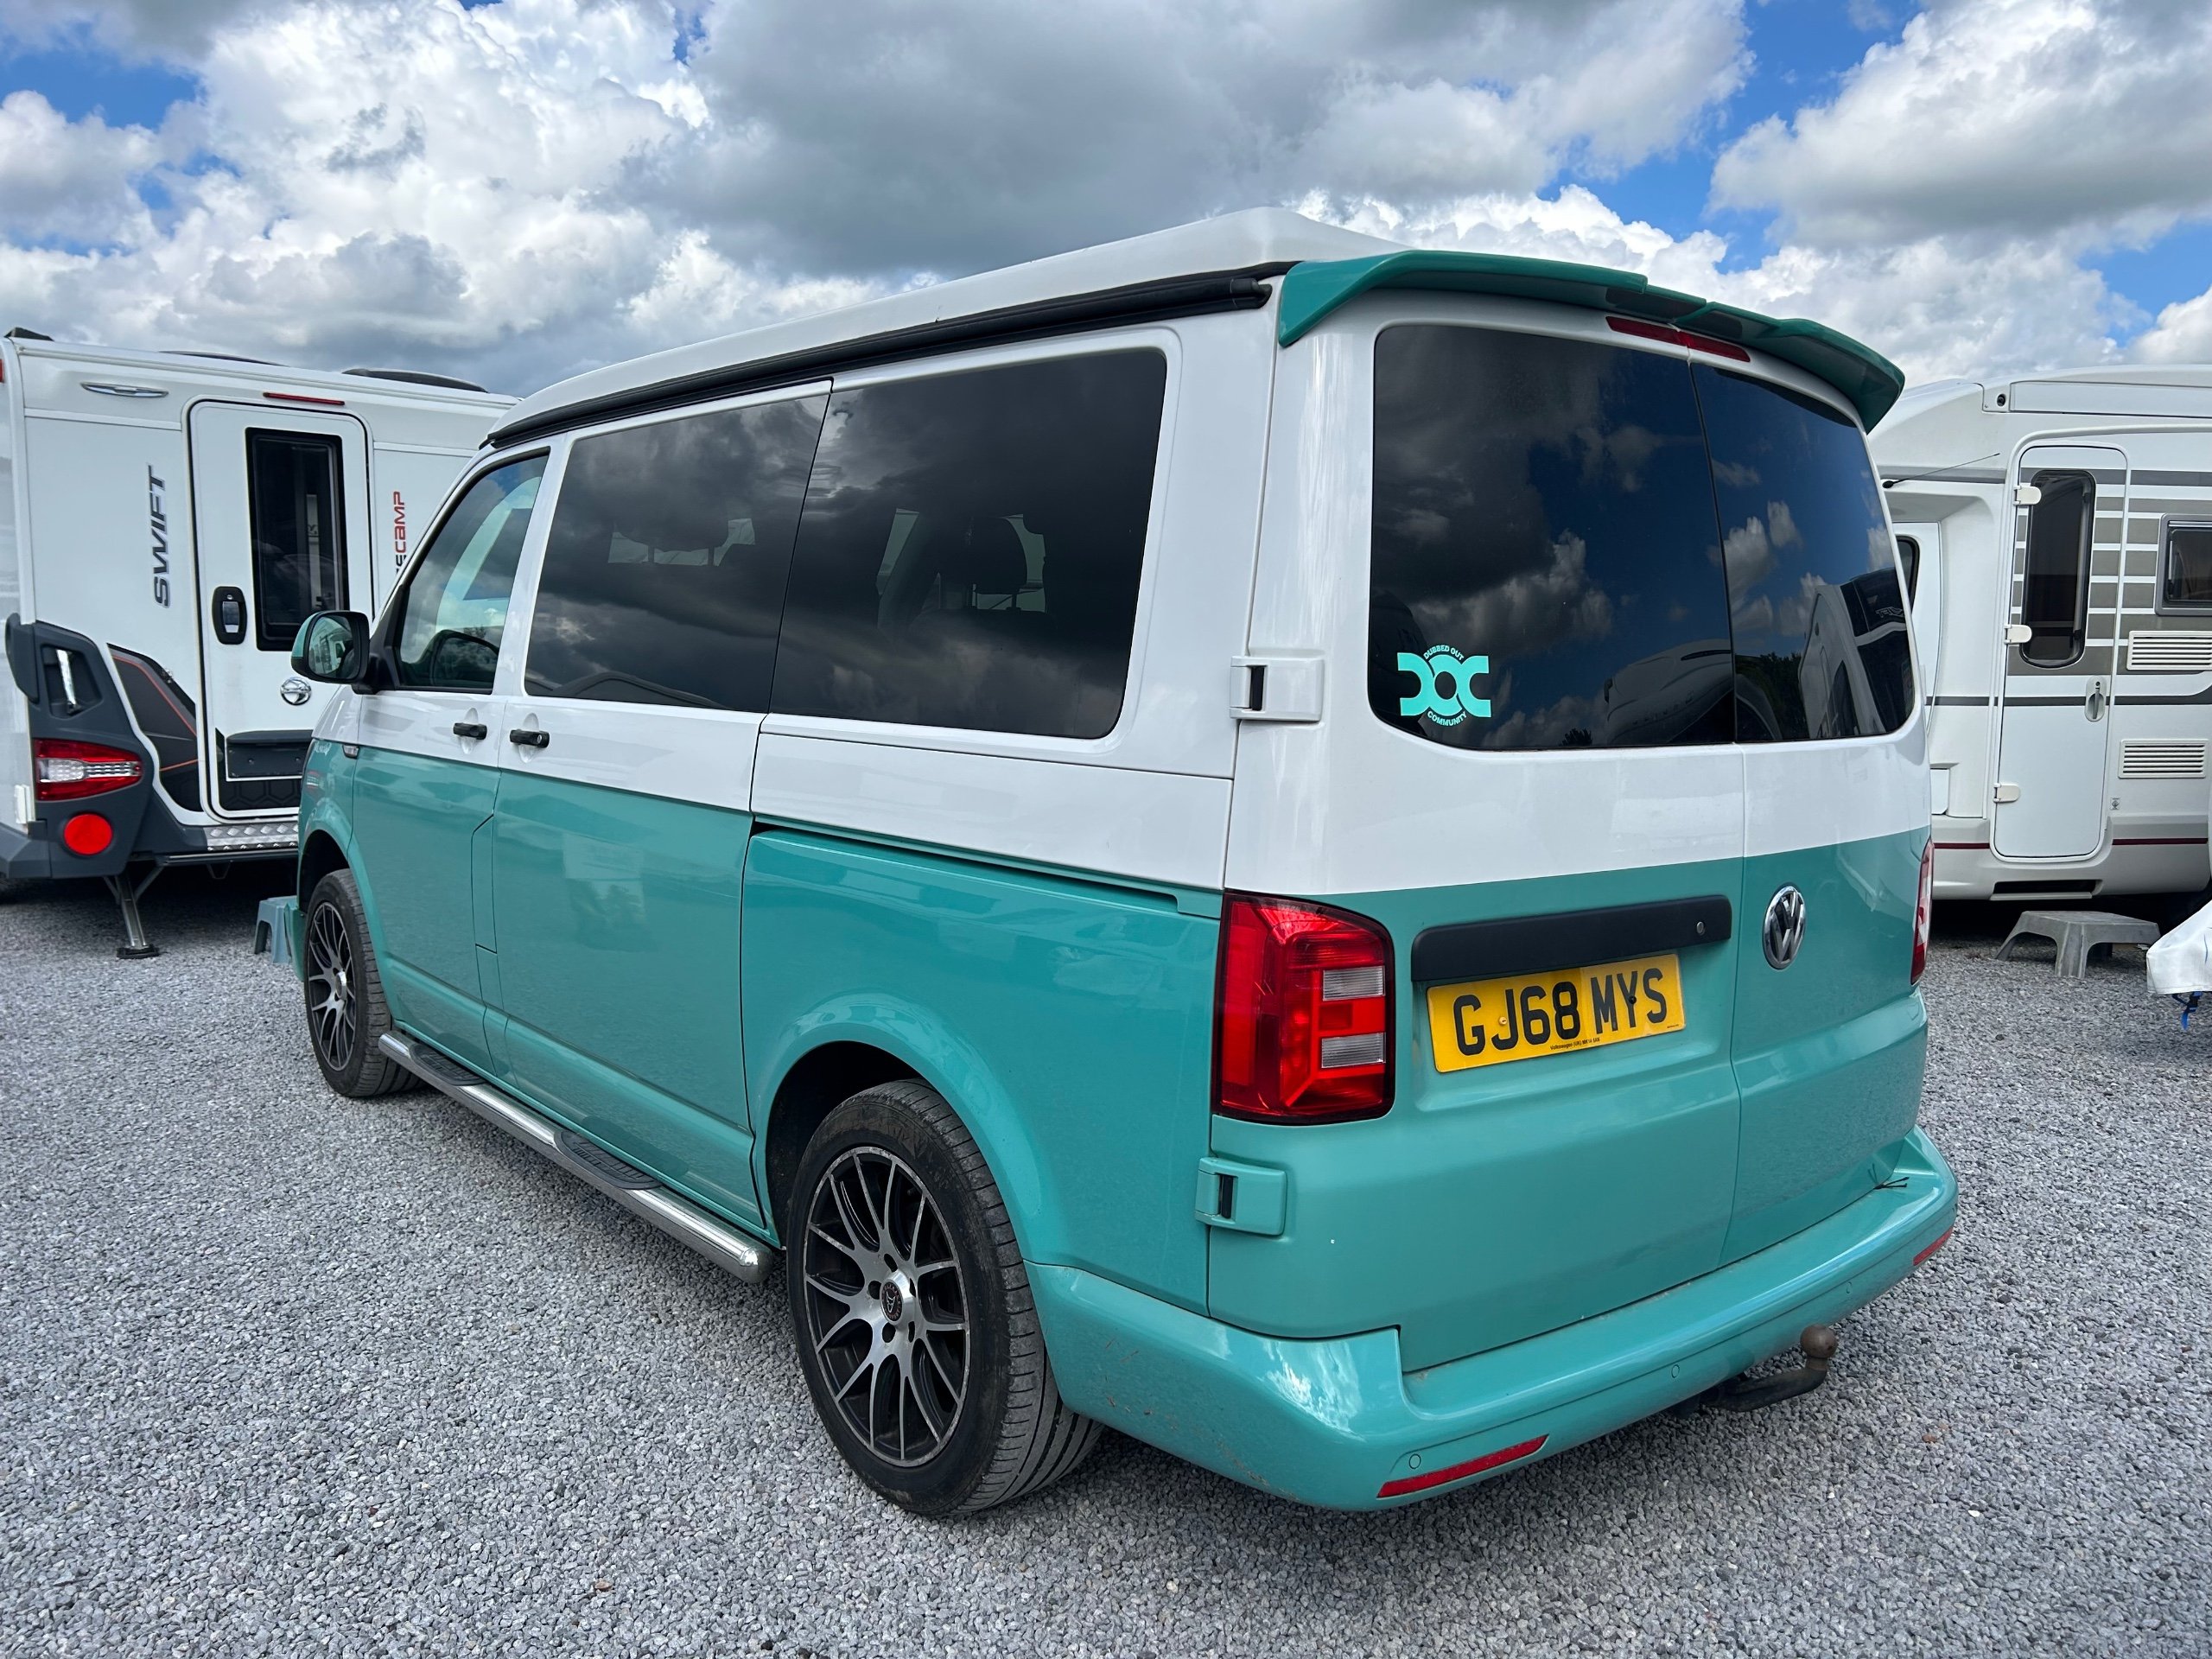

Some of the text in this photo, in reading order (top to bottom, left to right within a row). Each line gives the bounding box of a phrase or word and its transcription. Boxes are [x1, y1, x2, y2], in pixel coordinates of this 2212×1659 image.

[148, 464, 170, 607] SWIFT
[1423, 645, 1465, 660] DUBBED OUT
[1427, 710, 1467, 727] COMMUNITY
[1453, 967, 1668, 1057] GJ68 MYS
